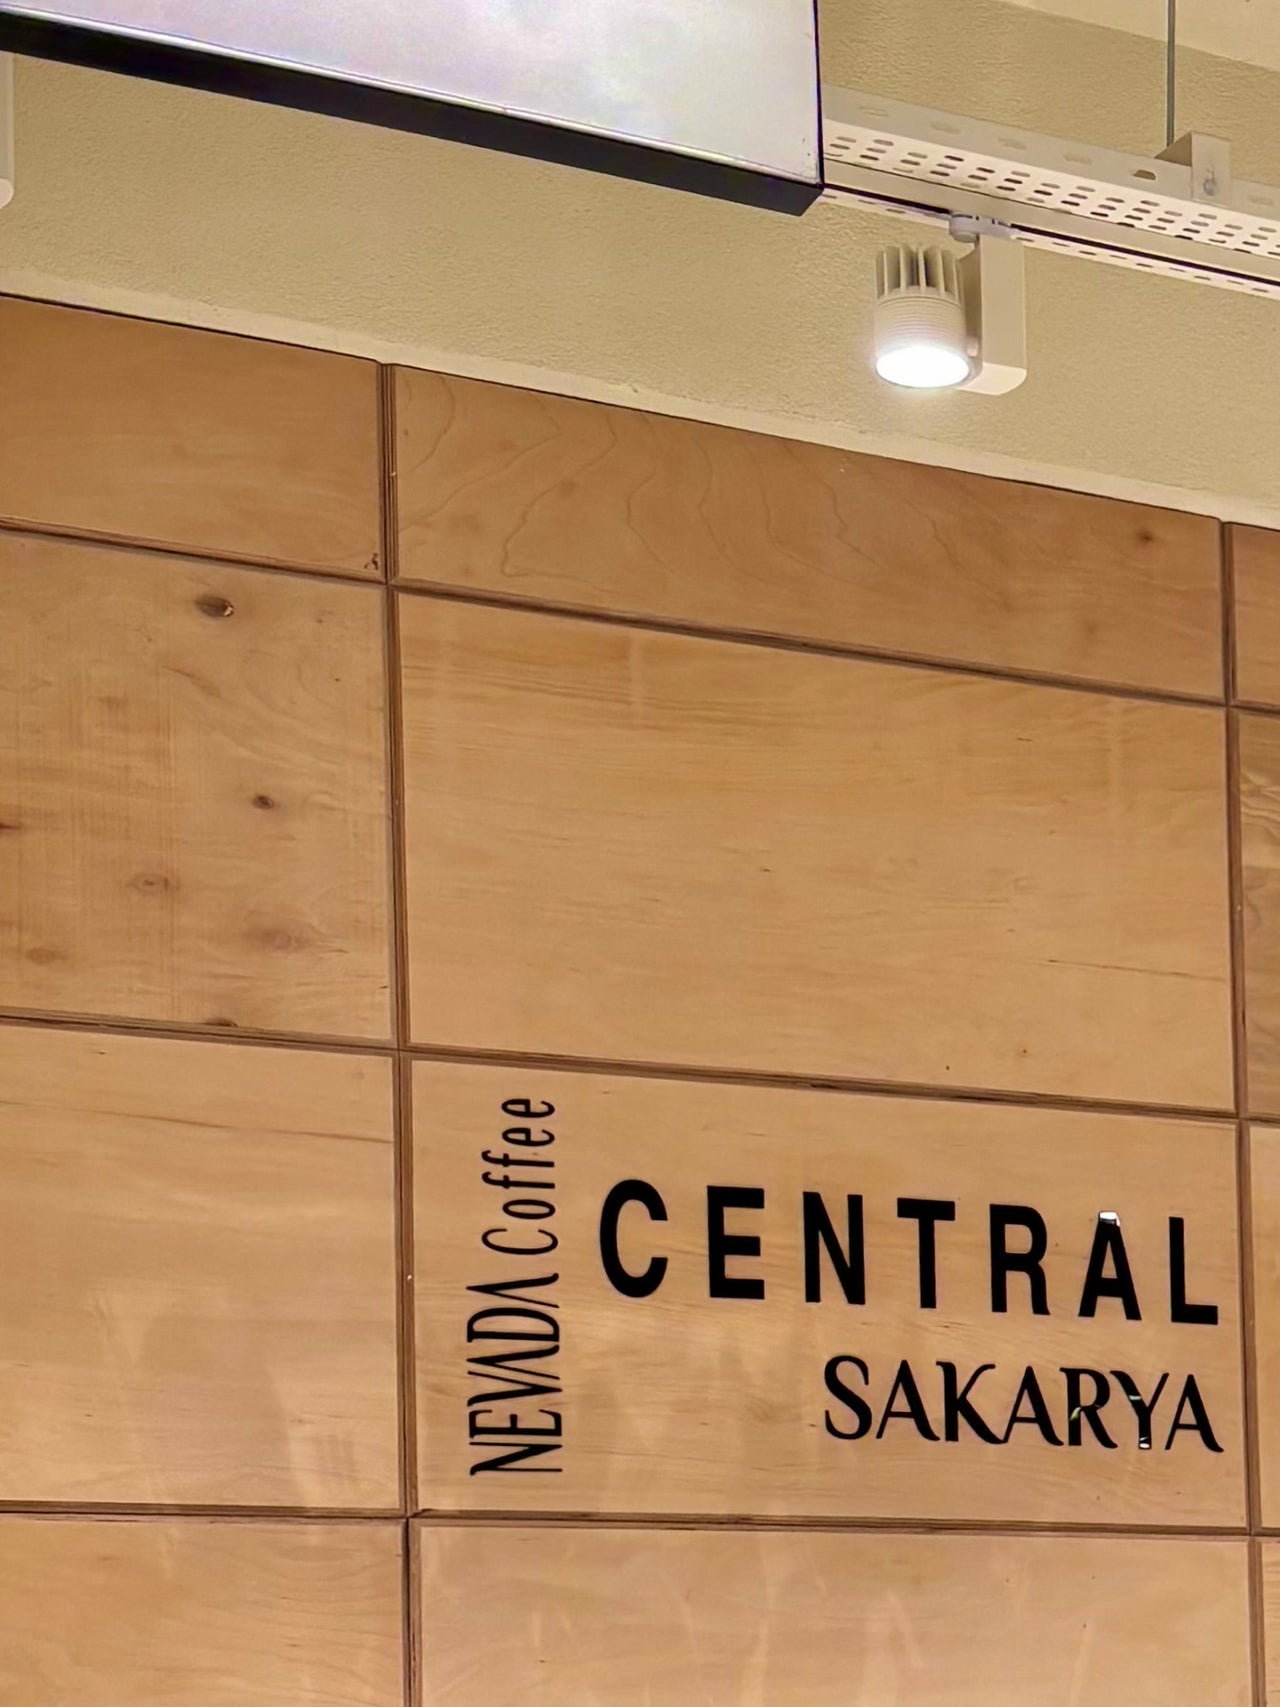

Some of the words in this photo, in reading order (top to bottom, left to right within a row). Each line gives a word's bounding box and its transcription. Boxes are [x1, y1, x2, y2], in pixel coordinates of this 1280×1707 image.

[481, 1097, 558, 1256] Coffee
[600, 1178, 1219, 1326] CENTRAL
[466, 1272, 563, 1476] NEVADA
[823, 1354, 1225, 1453] SAKARYA
